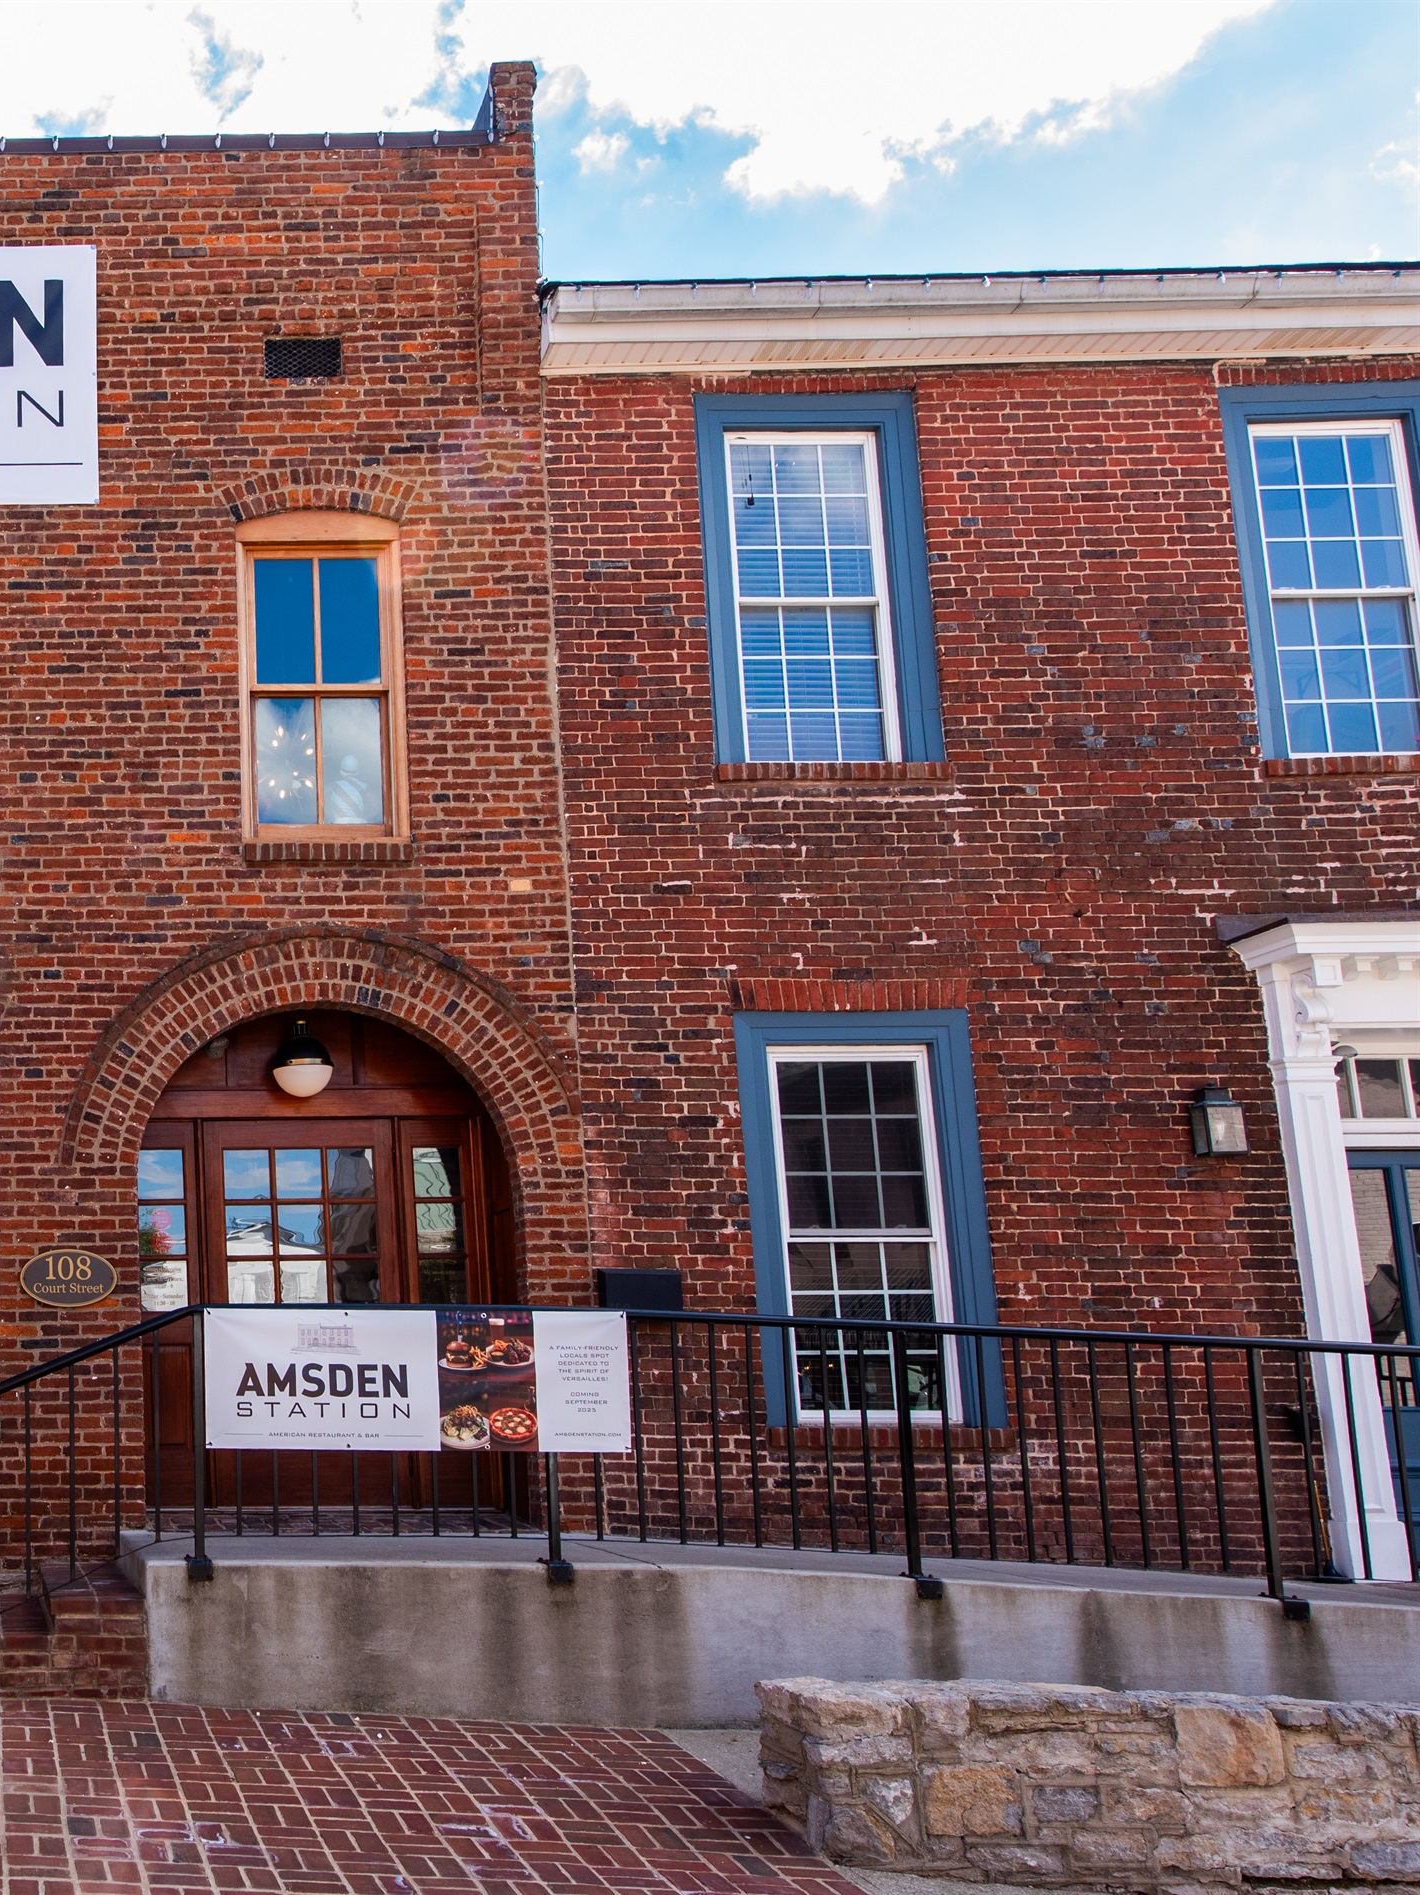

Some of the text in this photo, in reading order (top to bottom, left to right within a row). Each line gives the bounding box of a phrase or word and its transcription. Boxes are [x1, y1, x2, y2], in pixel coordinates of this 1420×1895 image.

[46, 1256, 91, 1280] 108
[33, 1282, 104, 1293] Court Street
[236, 1363, 409, 1398] AMSDEN
[236, 1402, 410, 1419] STATION
